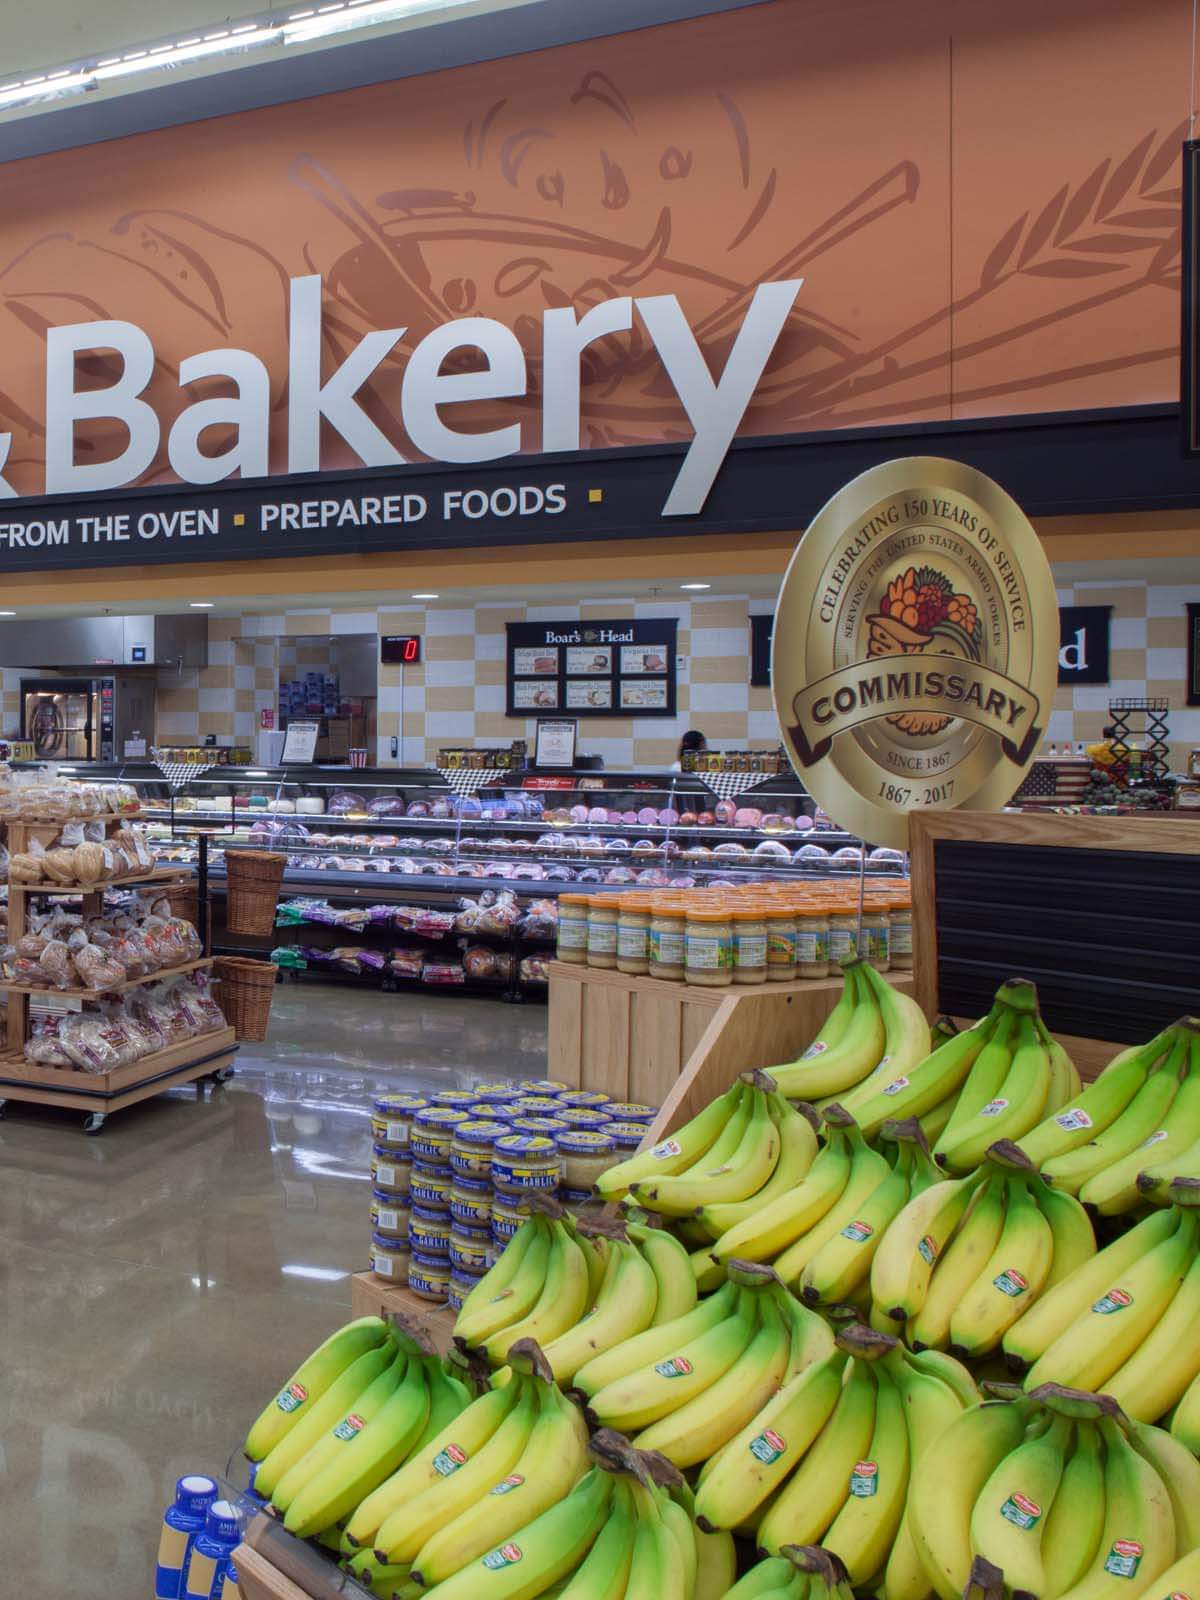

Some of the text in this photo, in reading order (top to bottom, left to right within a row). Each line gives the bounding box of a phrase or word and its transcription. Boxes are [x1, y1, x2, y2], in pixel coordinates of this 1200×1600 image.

[45, 274, 804, 518] Bakery
[76, 512, 131, 543] THE
[137, 507, 219, 540] OVEN
[260, 494, 427, 532] PREPARED
[443, 484, 567, 520] FOODS
[819, 498, 1025, 633] CELEBRATING 150 YEARS OF SERVICE
[844, 581, 868, 640] SERVING
[887, 533, 926, 556] UNITED
[928, 533, 966, 556] STATES
[545, 628, 635, 644] Boar's Head
[811, 670, 1026, 725] COMMISSARY
[885, 750, 951, 770] SINCE 1867
[878, 780, 912, 806] 1867
[924, 779, 955, 806] 2017
